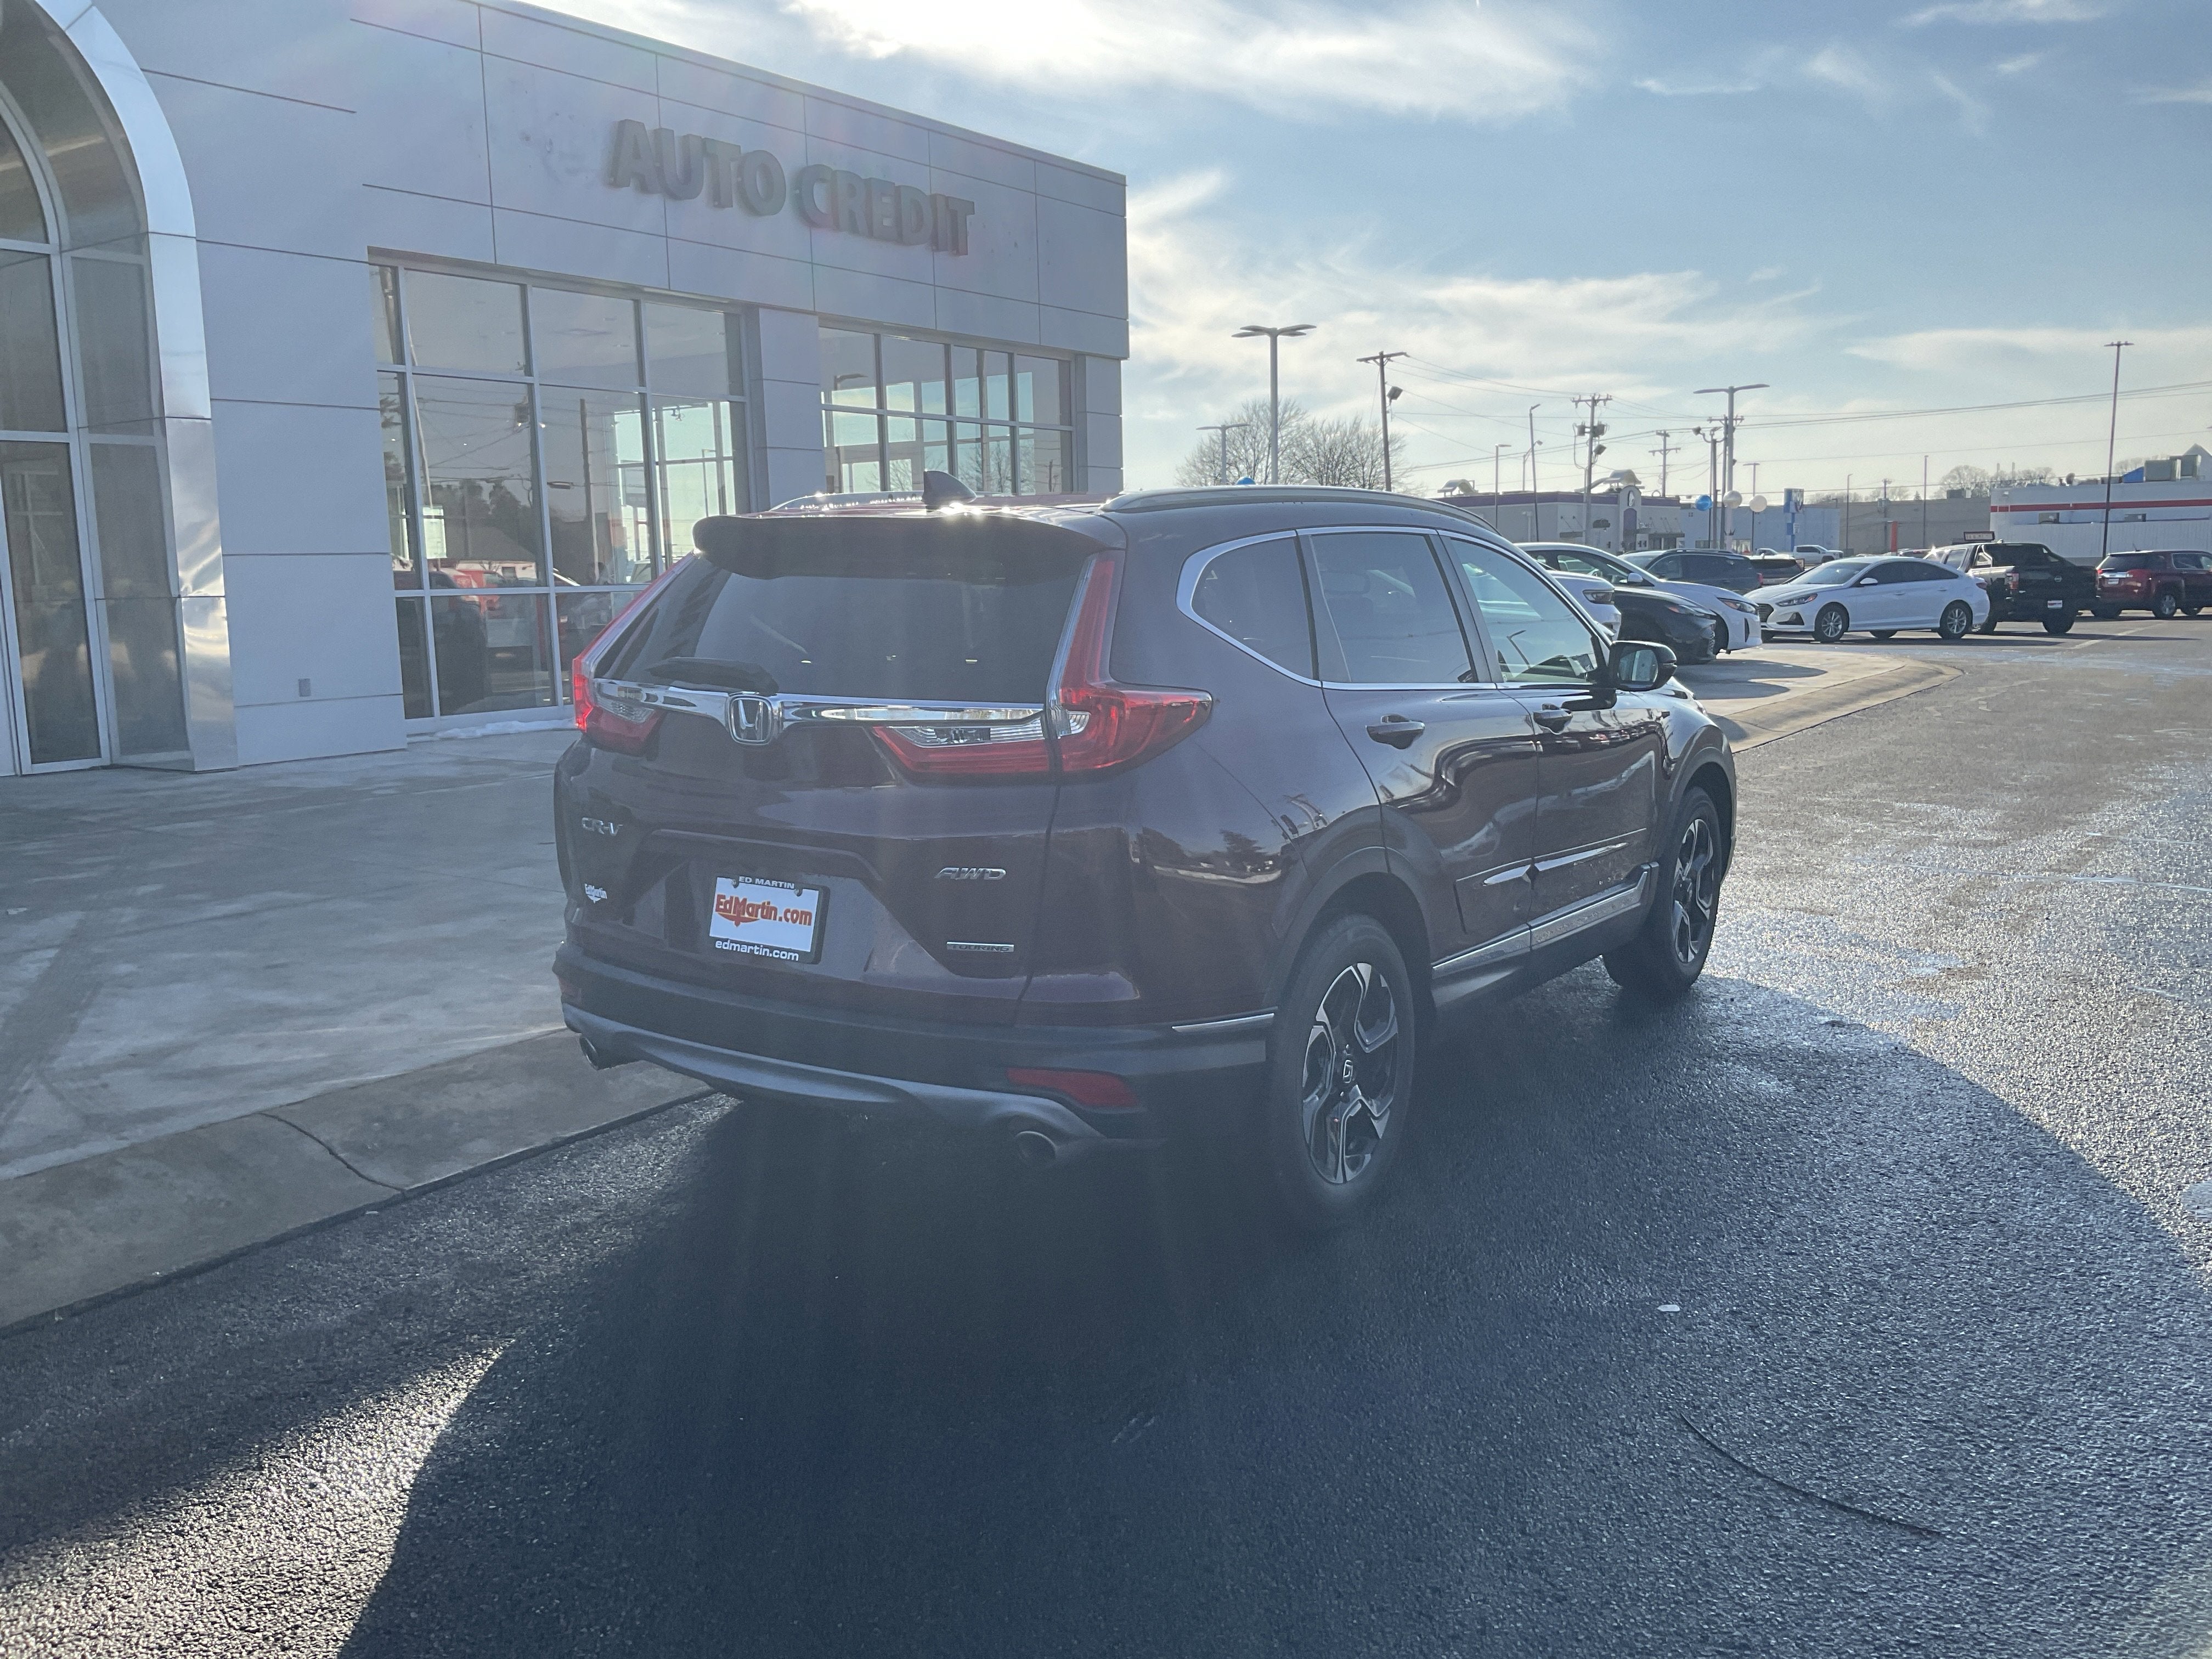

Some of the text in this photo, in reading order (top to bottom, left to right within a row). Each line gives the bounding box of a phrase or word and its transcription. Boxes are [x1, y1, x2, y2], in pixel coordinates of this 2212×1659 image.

[607, 118, 975, 256] AUTO CREDIT
[934, 867, 1006, 880] AWD
[738, 876, 795, 889] ED MARTIN
[715, 894, 812, 927] EdMartin.com
[715, 939, 799, 961] edmartin.com
[952, 944, 1010, 952] TOURING
